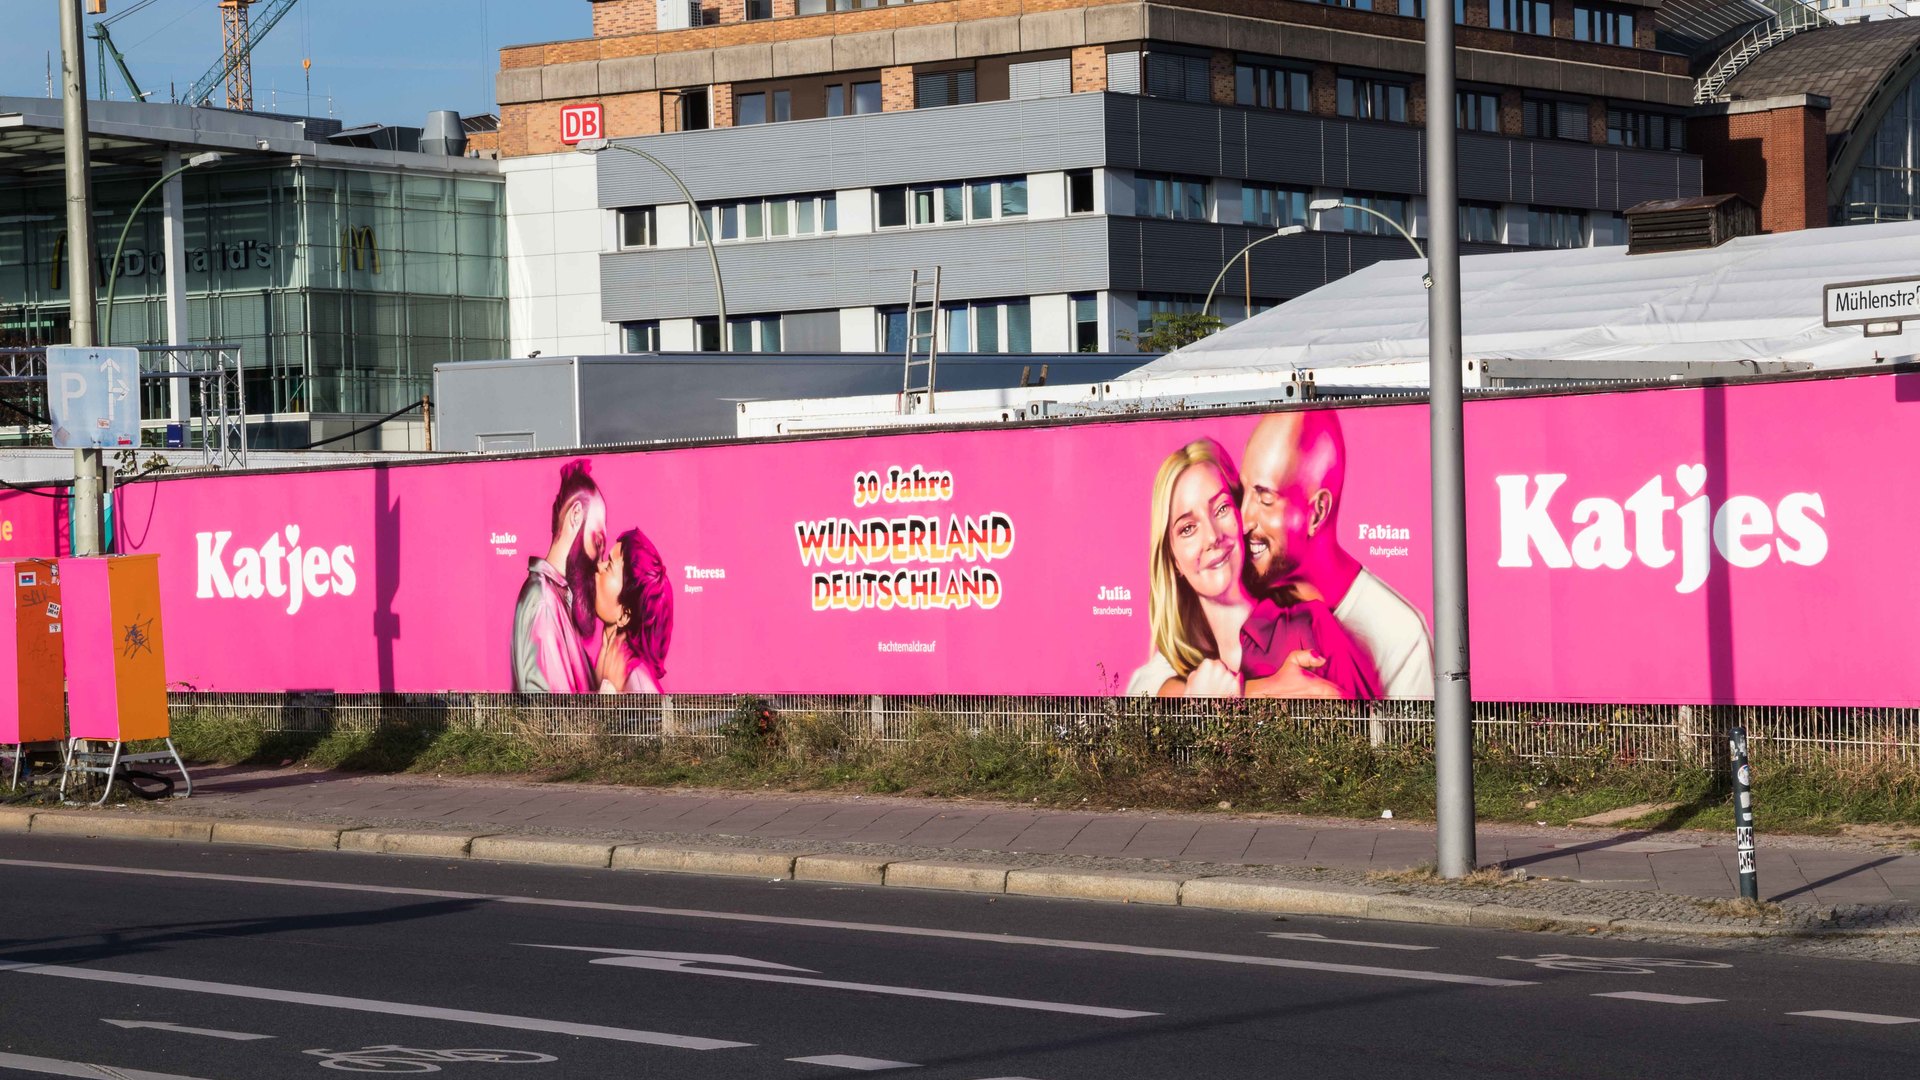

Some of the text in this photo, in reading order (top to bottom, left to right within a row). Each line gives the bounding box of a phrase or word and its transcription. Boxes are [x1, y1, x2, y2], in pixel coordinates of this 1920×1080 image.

[566, 110, 597, 138] DB
[61, 372, 87, 421] P
[854, 467, 952, 506] 30 Jahre
[490, 532, 517, 544] Janko
[796, 512, 1014, 566] WUNDERLAND
[1358, 523, 1410, 540] Fabian
[1495, 463, 1829, 594] Katjes
[1369, 545, 1409, 558] Ruhrgebiet
[195, 524, 357, 615] Katjes
[684, 565, 726, 579] Theresa
[813, 568, 1002, 610] DEUTSCHLAND
[1097, 585, 1132, 600] Julia
[1092, 606, 1133, 617] Brandenburg
[878, 640, 936, 653] #achtemaldrauf
